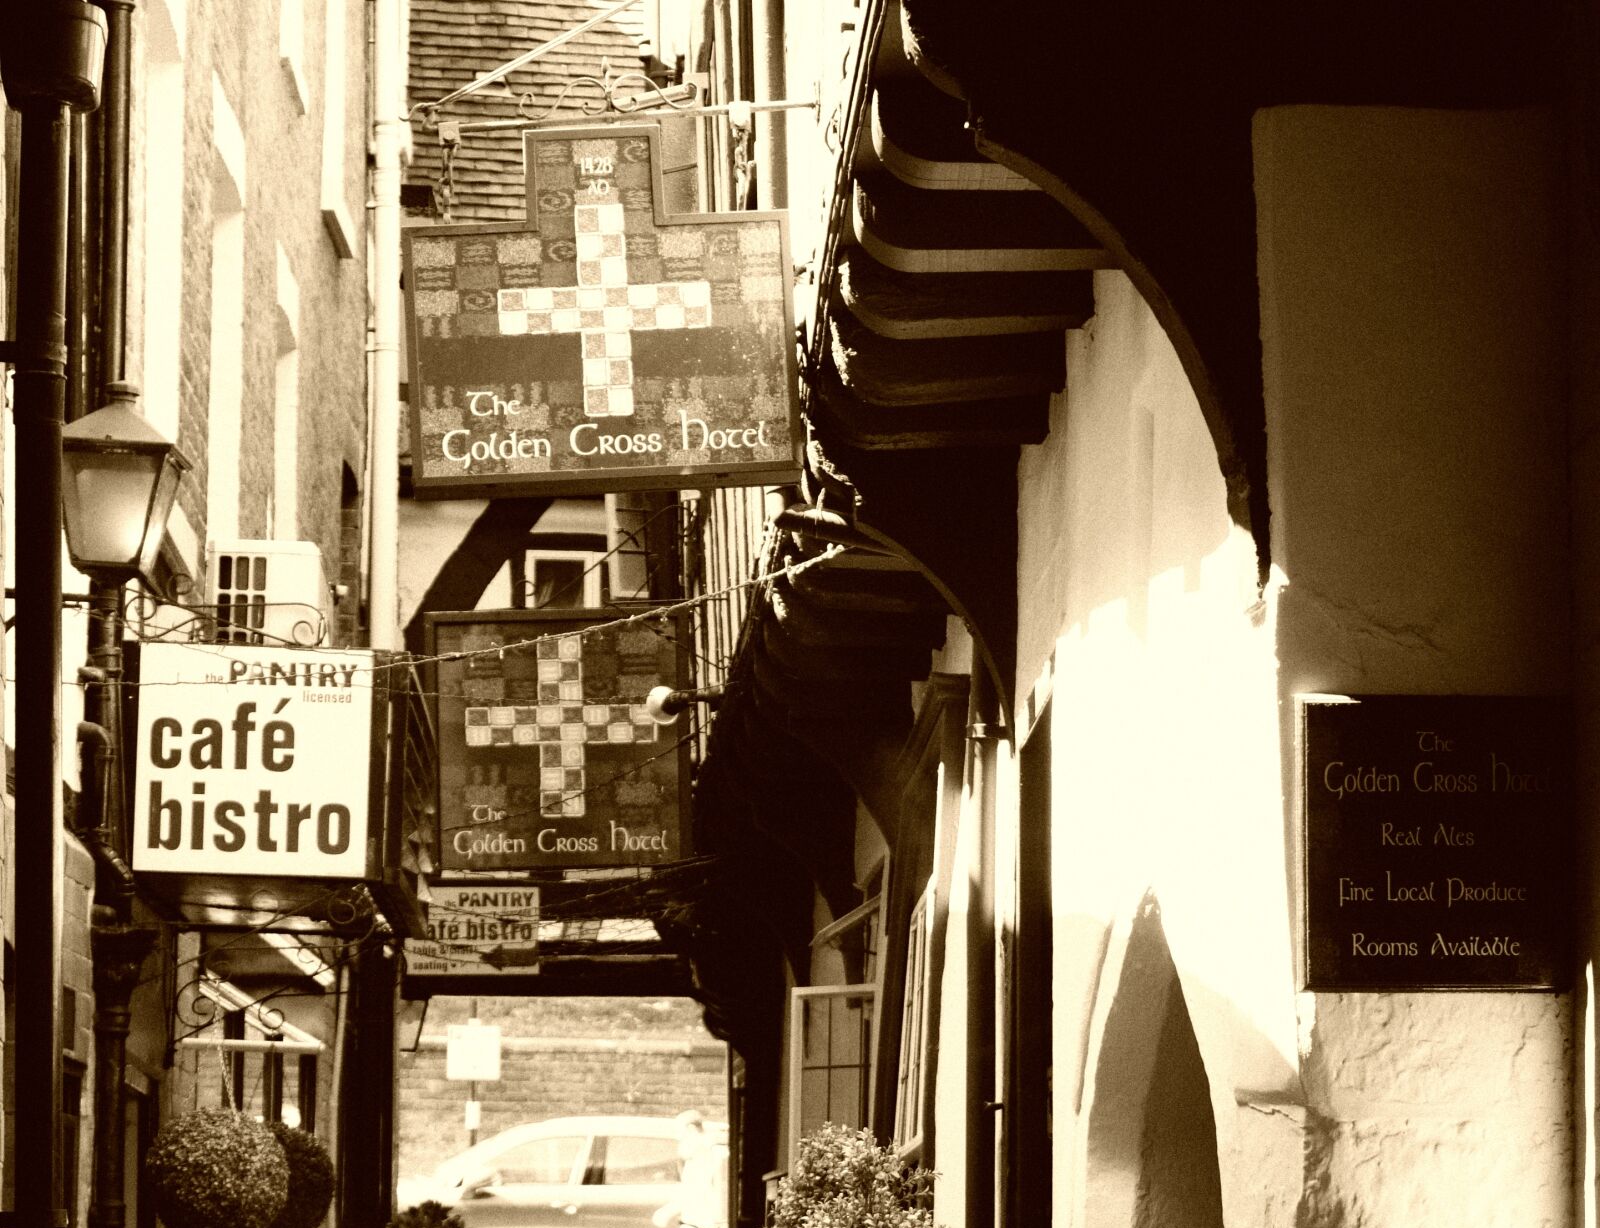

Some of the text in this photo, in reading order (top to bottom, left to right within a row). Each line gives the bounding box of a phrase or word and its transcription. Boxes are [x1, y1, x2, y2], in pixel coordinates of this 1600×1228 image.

[580, 157, 613, 176] 1428
[466, 391, 521, 416] The
[442, 429, 551, 469] Golden
[205, 660, 358, 688] the PANTRY
[302, 690, 352, 704] licensed
[150, 697, 295, 772] café
[1416, 731, 1454, 751] The
[1324, 762, 1400, 800] Golden
[147, 780, 351, 855] bistro
[471, 804, 507, 821] The
[453, 830, 526, 860] Golden
[1382, 822, 1475, 846] Real Ales
[458, 892, 534, 907] PANTRY
[1338, 870, 1528, 908] Fine Local Produce
[427, 917, 532, 940] afé bistro
[1352, 932, 1521, 956] Rooms Available
[413, 961, 448, 972] seating
